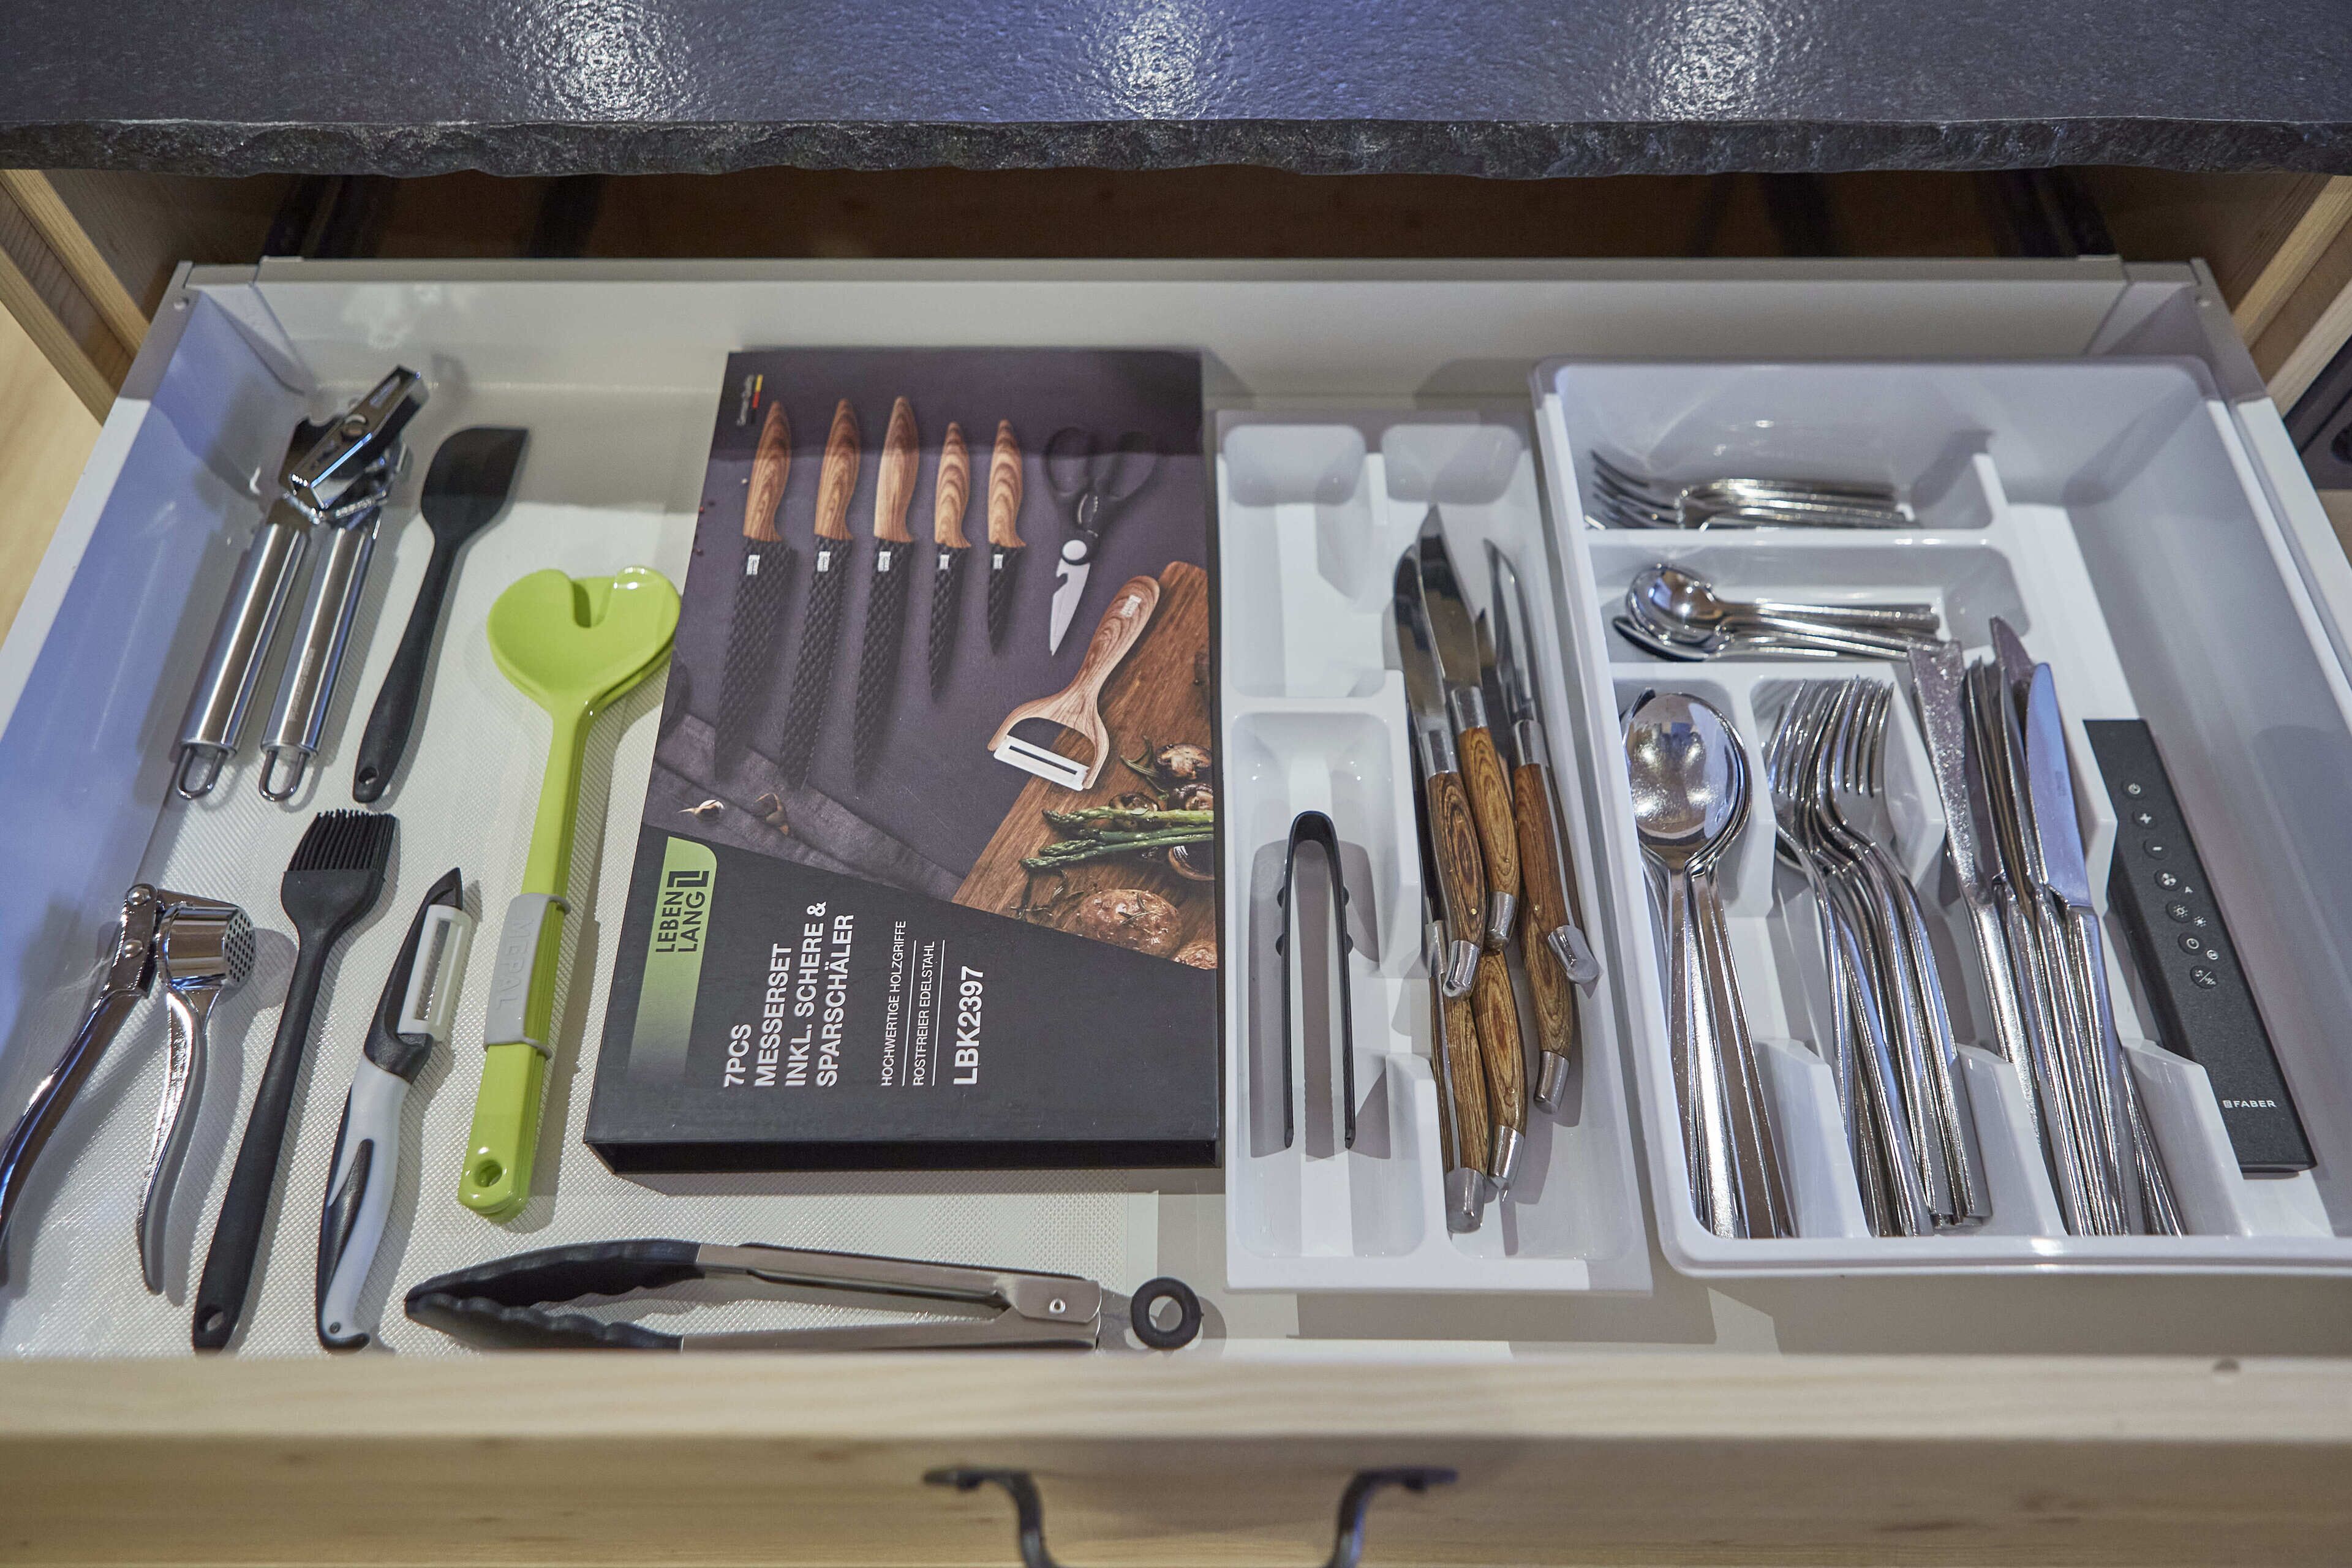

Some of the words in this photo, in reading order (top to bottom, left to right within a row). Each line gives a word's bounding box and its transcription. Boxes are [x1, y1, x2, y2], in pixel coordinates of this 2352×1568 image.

[656, 892, 684, 952] LEBEN
[678, 891, 706, 952] LANG
[807, 901, 826, 917] &
[794, 923, 823, 1017] SCHERE
[890, 921, 907, 993] HOLZGRIFFE
[919, 941, 935, 1007] EDELSTAHL
[754, 943, 791, 1087] MESSERSET
[816, 915, 854, 1087] SPARSCHÄLER
[953, 965, 984, 1085] LBK2397
[723, 1024, 752, 1087] 7PCS
[785, 1023, 812, 1087] INKL.
[881, 995, 900, 1087] HOCHWERTIGE
[913, 1011, 930, 1086] ROSTFREIER
